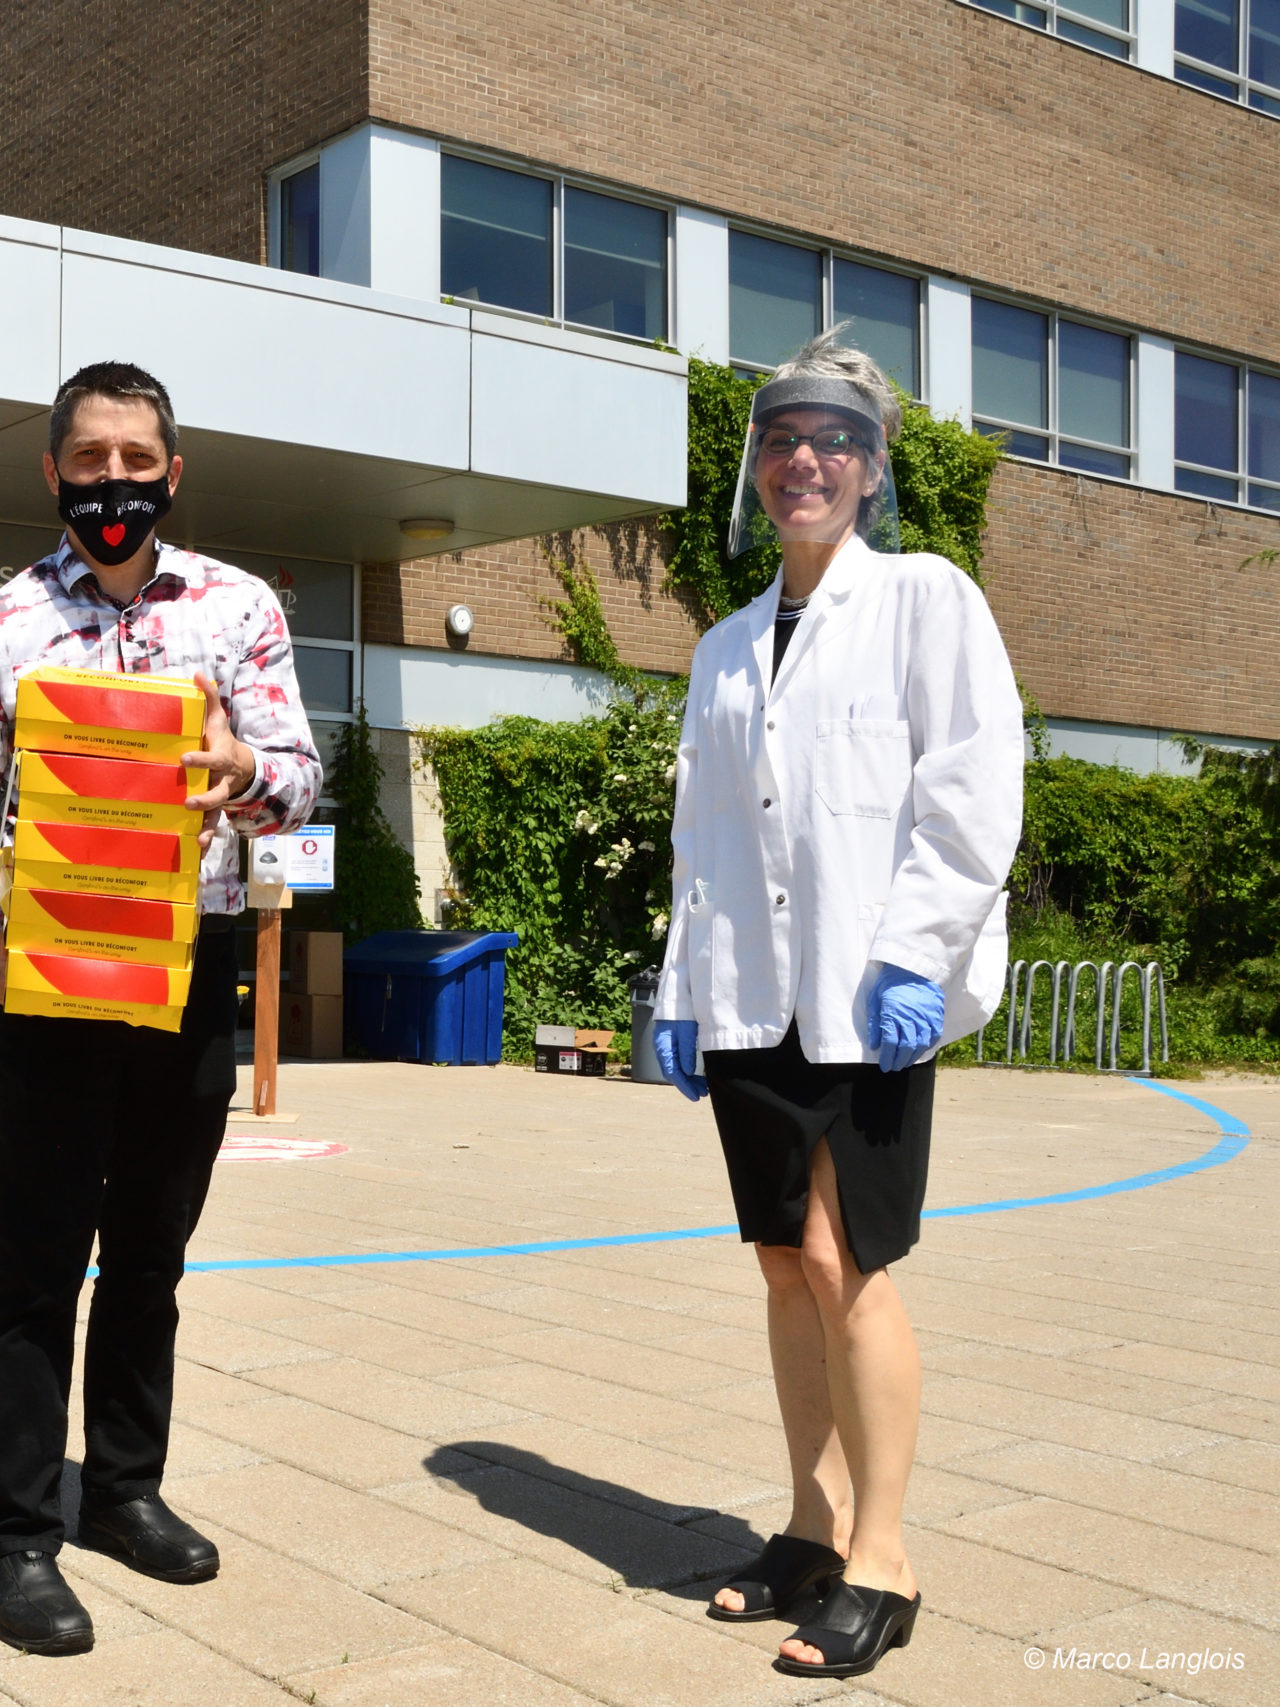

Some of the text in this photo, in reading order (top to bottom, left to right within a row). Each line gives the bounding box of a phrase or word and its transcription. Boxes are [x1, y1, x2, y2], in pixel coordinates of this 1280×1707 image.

[70, 502, 104, 518] L'ÉQUIPE
[116, 739, 148, 748] RÉCONFORT
[121, 811, 152, 819] RÉCONFORT
[115, 878, 147, 886] RÉCONFORT
[106, 942, 137, 952] RÉCONFORT
